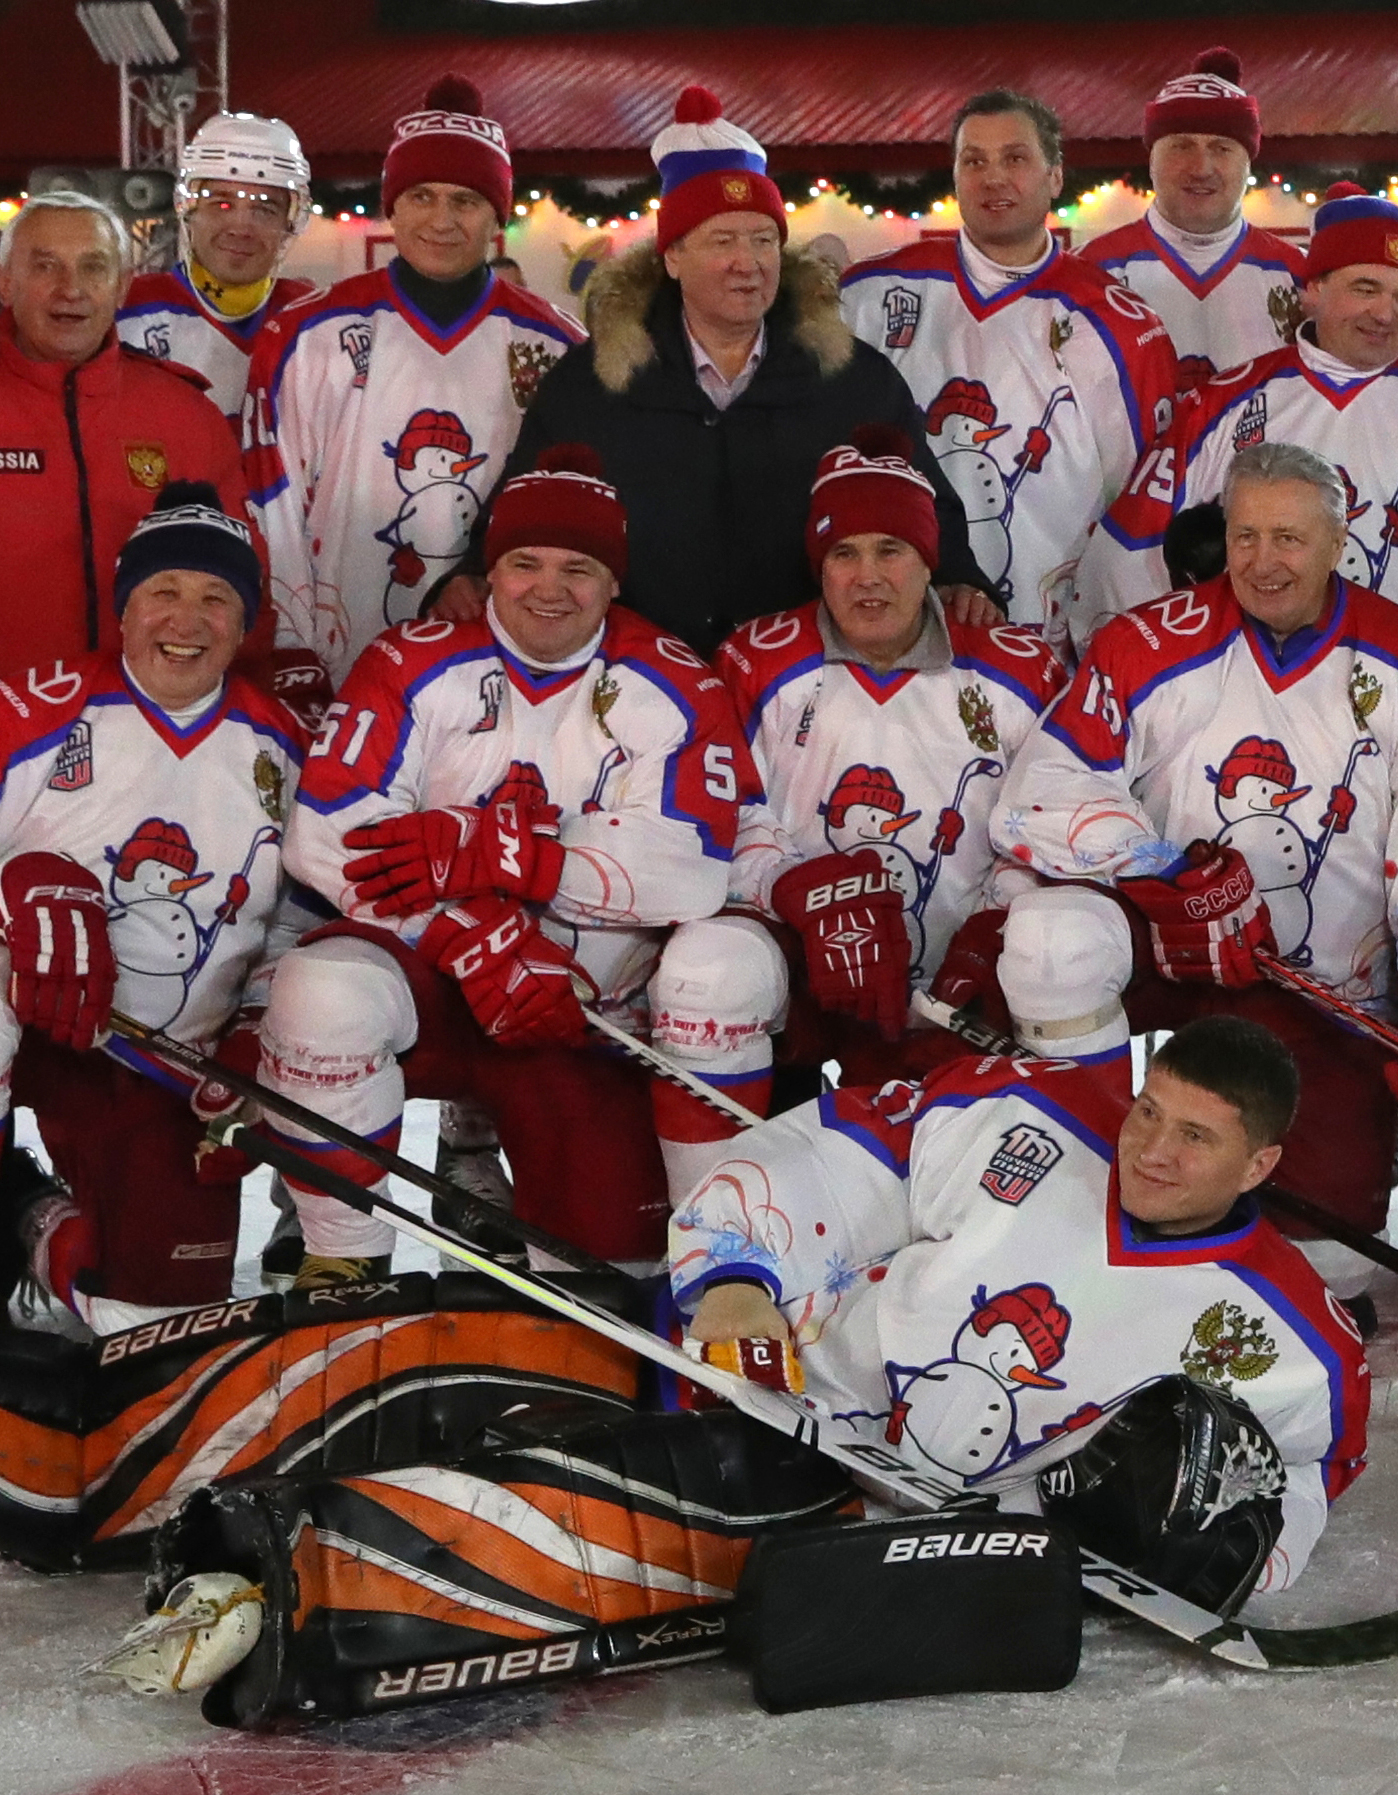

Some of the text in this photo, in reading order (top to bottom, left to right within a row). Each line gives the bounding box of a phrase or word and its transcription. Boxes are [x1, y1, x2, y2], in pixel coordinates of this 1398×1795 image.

[307, 701, 378, 768] 51
[805, 872, 905, 914] BAUE
[100, 1298, 260, 1368] BAUER
[883, 1531, 1050, 1564] BAUER
[374, 1640, 581, 1700] BAUER
